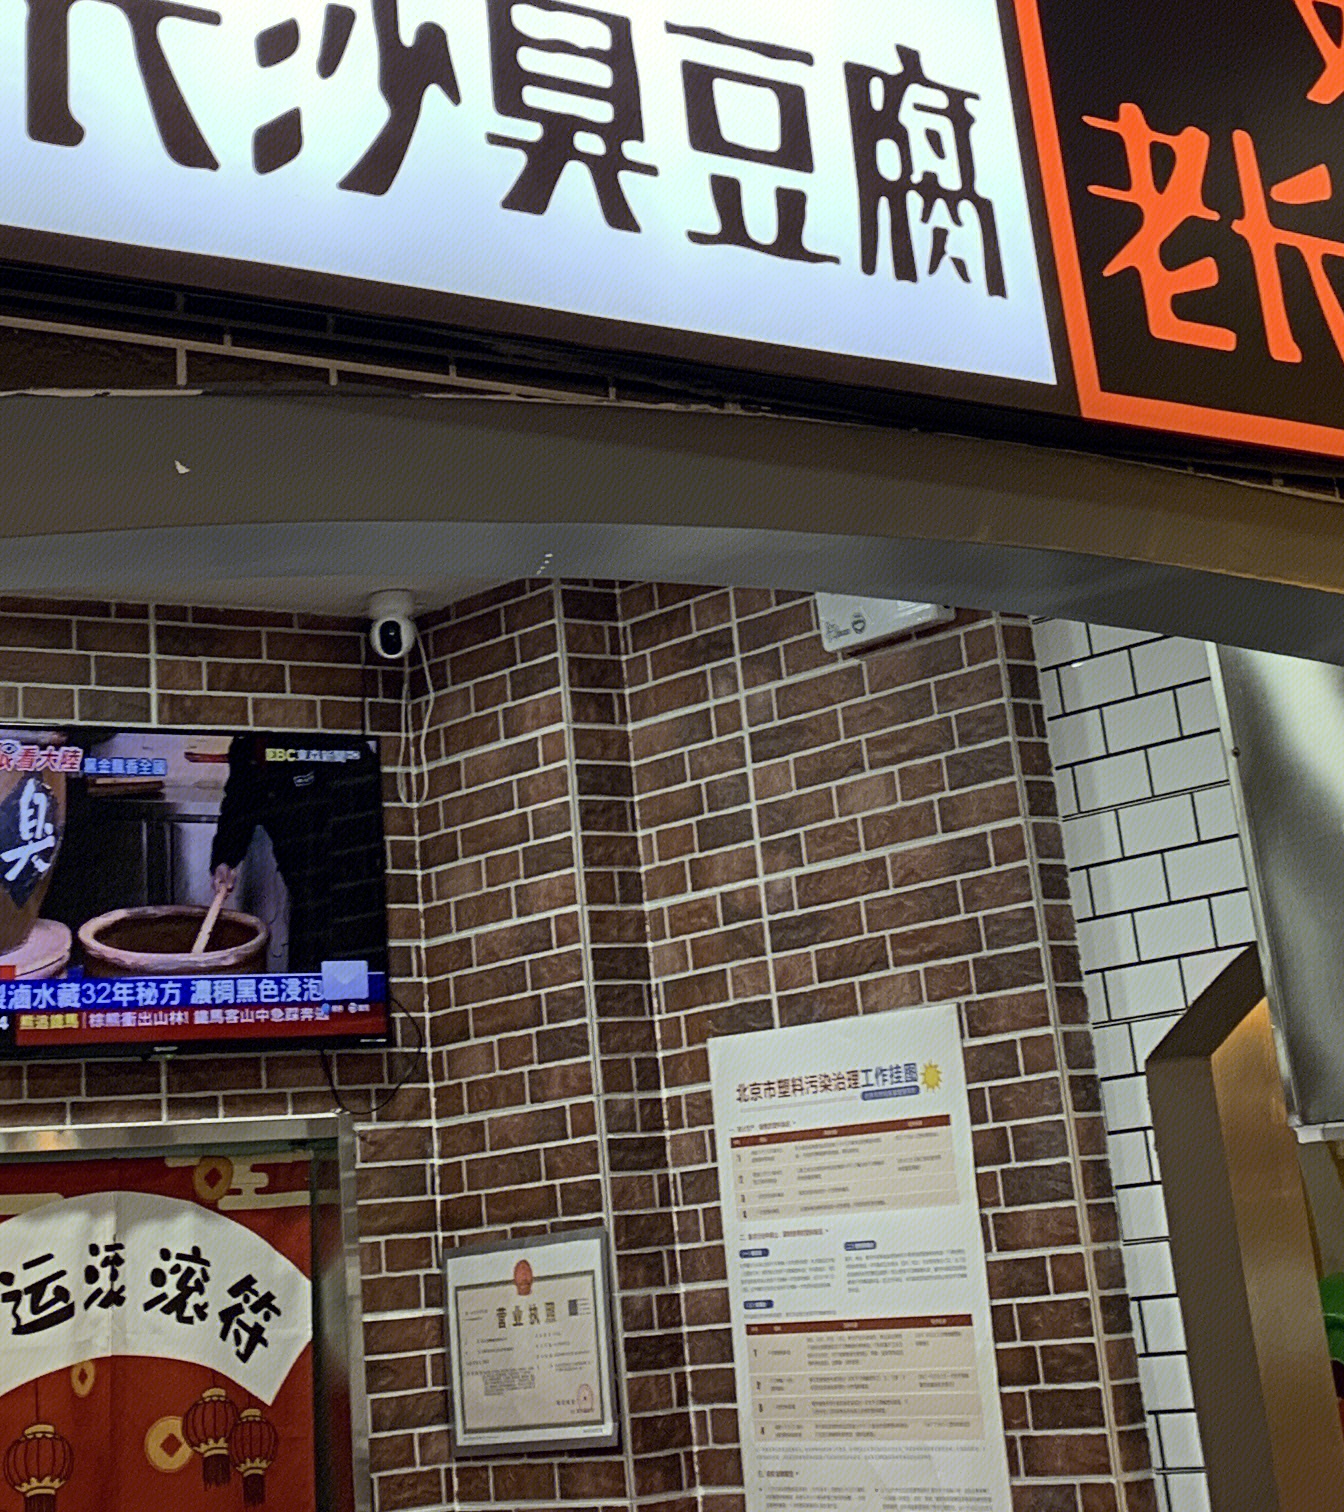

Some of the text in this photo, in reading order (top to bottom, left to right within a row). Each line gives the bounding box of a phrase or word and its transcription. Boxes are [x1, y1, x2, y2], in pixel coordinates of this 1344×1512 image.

[735, 1062, 919, 1104] 北京市塑料污染治理工作挂图
